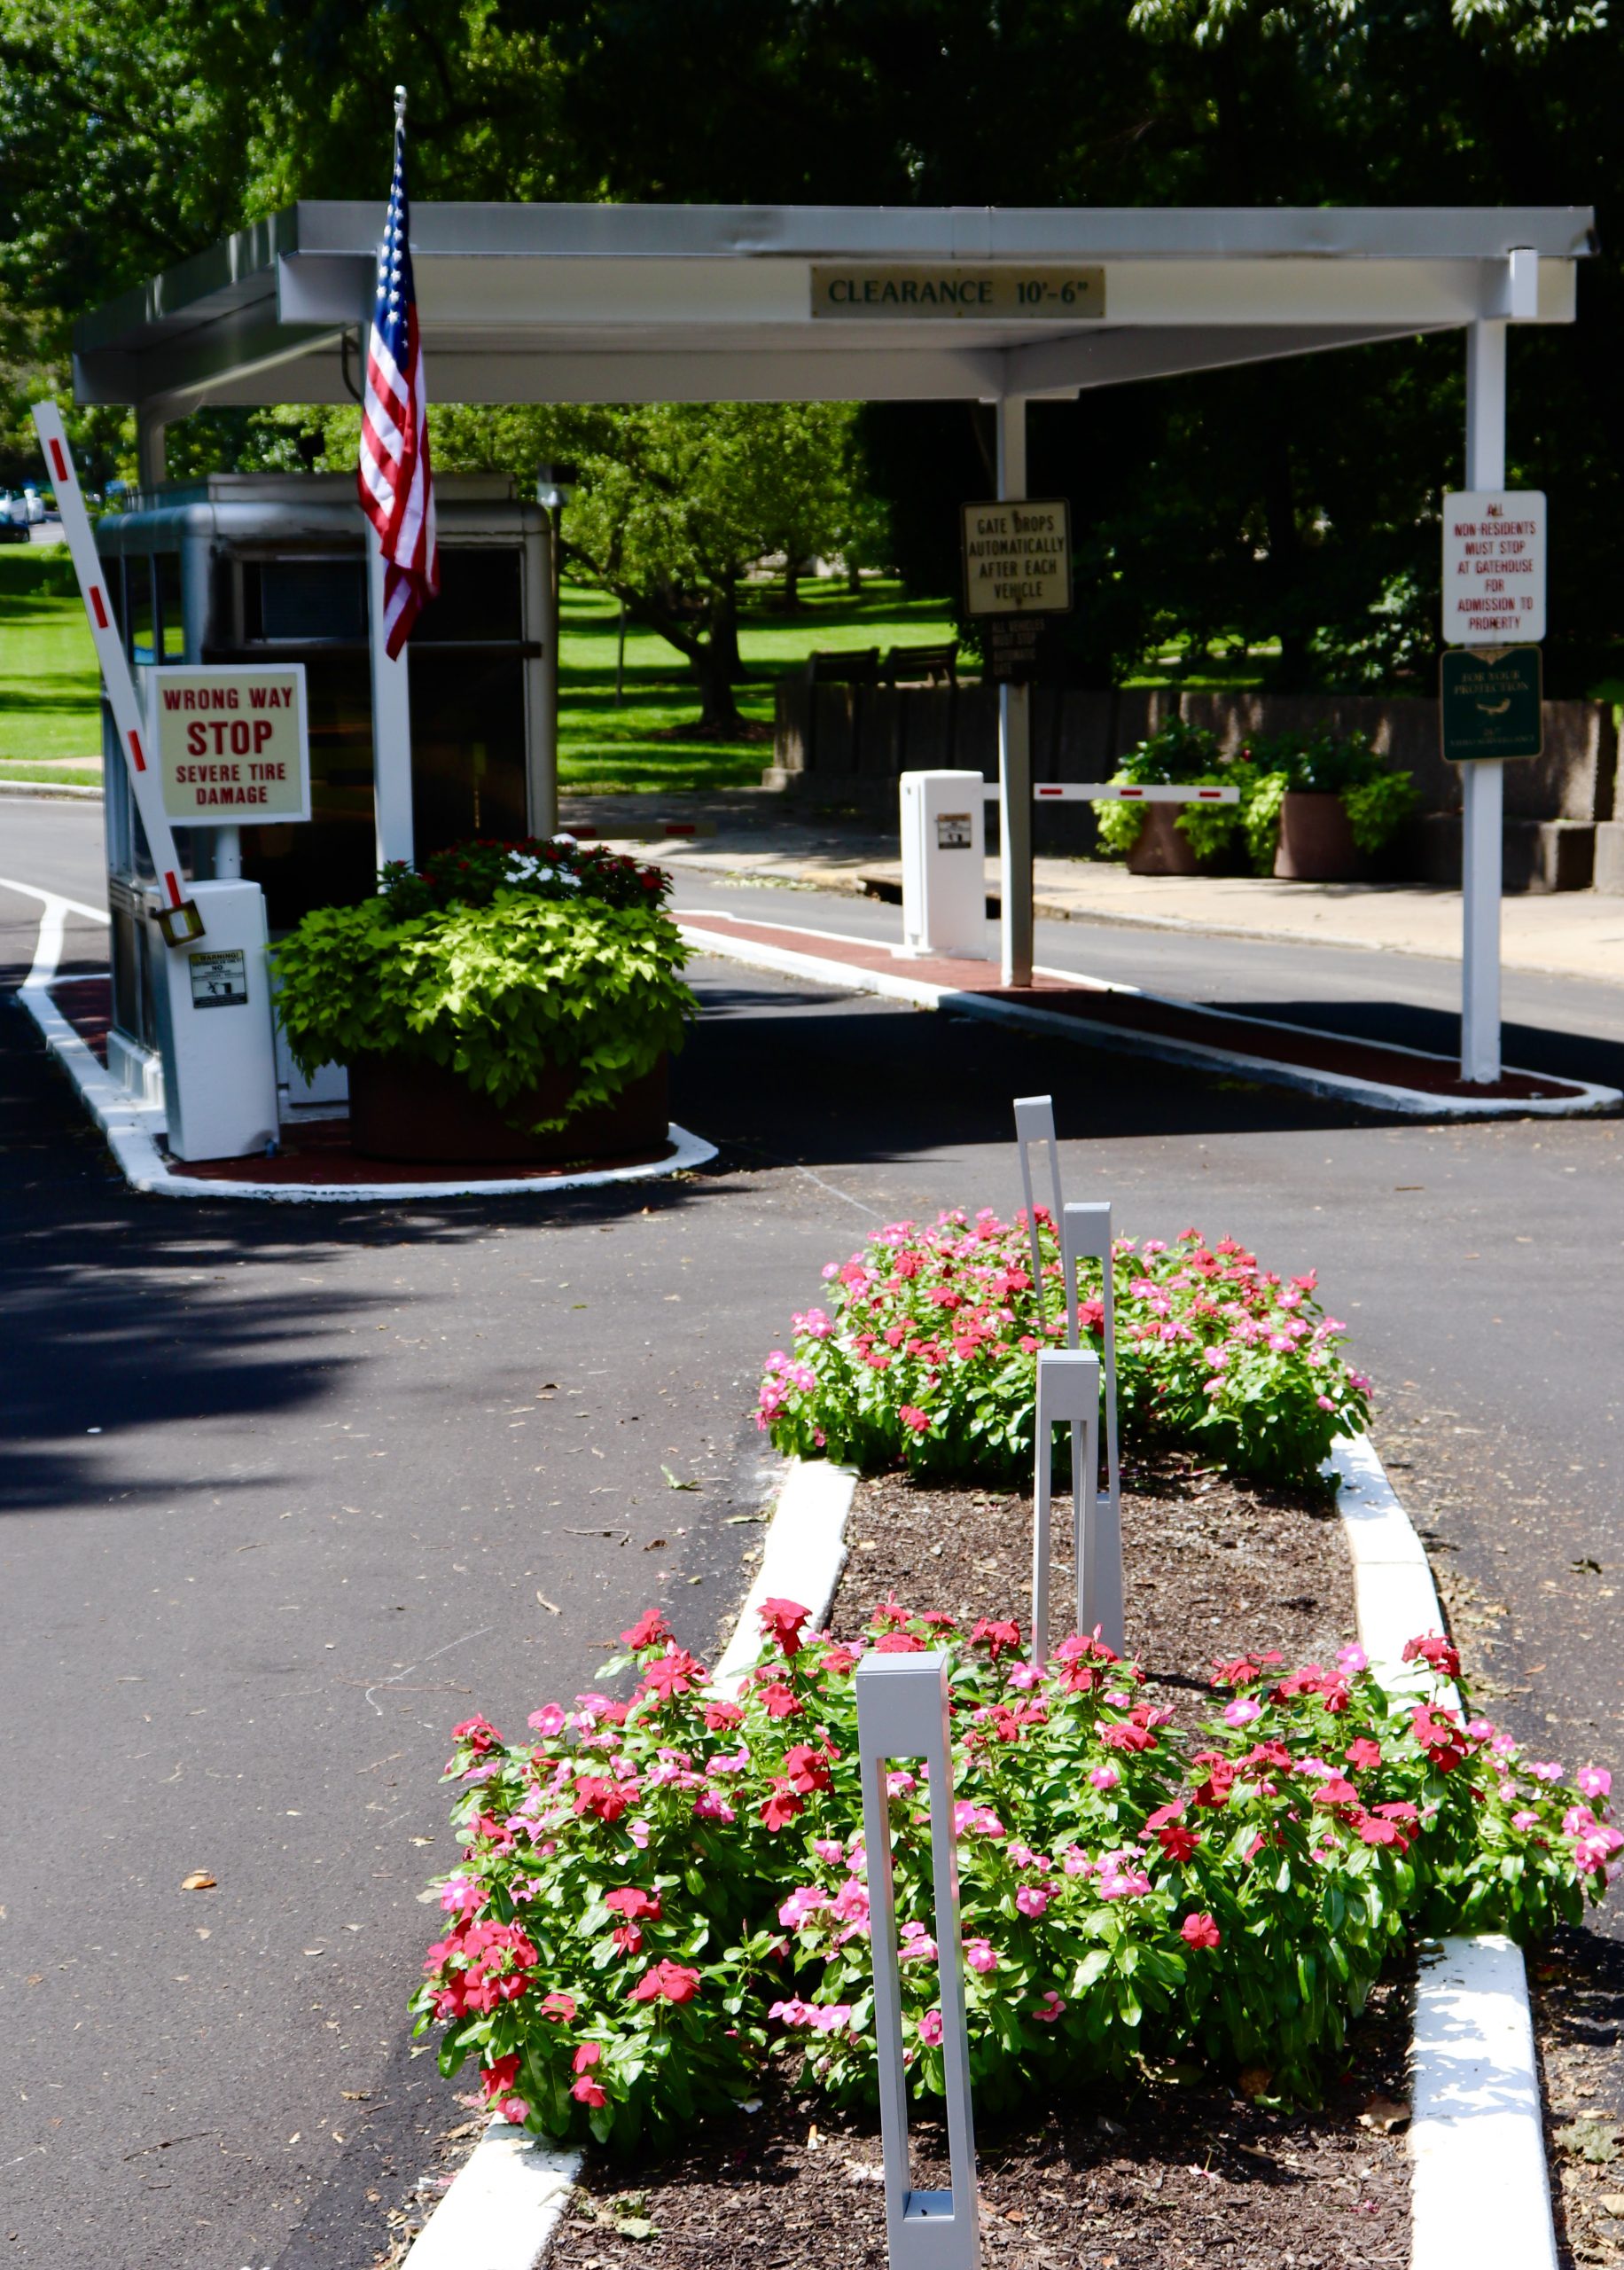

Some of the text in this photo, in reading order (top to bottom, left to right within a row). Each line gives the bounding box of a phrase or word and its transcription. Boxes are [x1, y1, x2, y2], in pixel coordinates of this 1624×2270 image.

[828, 279, 993, 303] CLEARANCE
[1487, 503, 1503, 516] ALL
[978, 515, 1054, 535] GATE DROPS
[1454, 521, 1536, 536] NON-RESIDENTS
[969, 536, 1064, 557] AUTOMATICALLY
[1465, 540, 1526, 555] MUST STOP
[979, 559, 1057, 578] AFTER EACH
[1457, 559, 1534, 574] AT GATEHOUSE
[994, 581, 1043, 599] VEHICLE
[1486, 578, 1504, 591] FOR
[1457, 596, 1533, 612] ADMISSION TO
[1468, 615, 1521, 630] PROPERTY
[163, 686, 293, 710] WRONG WAY
[187, 719, 273, 756] STOP
[176, 763, 286, 783] SEVERE TIRE
[196, 786, 268, 805] DAMAGE
